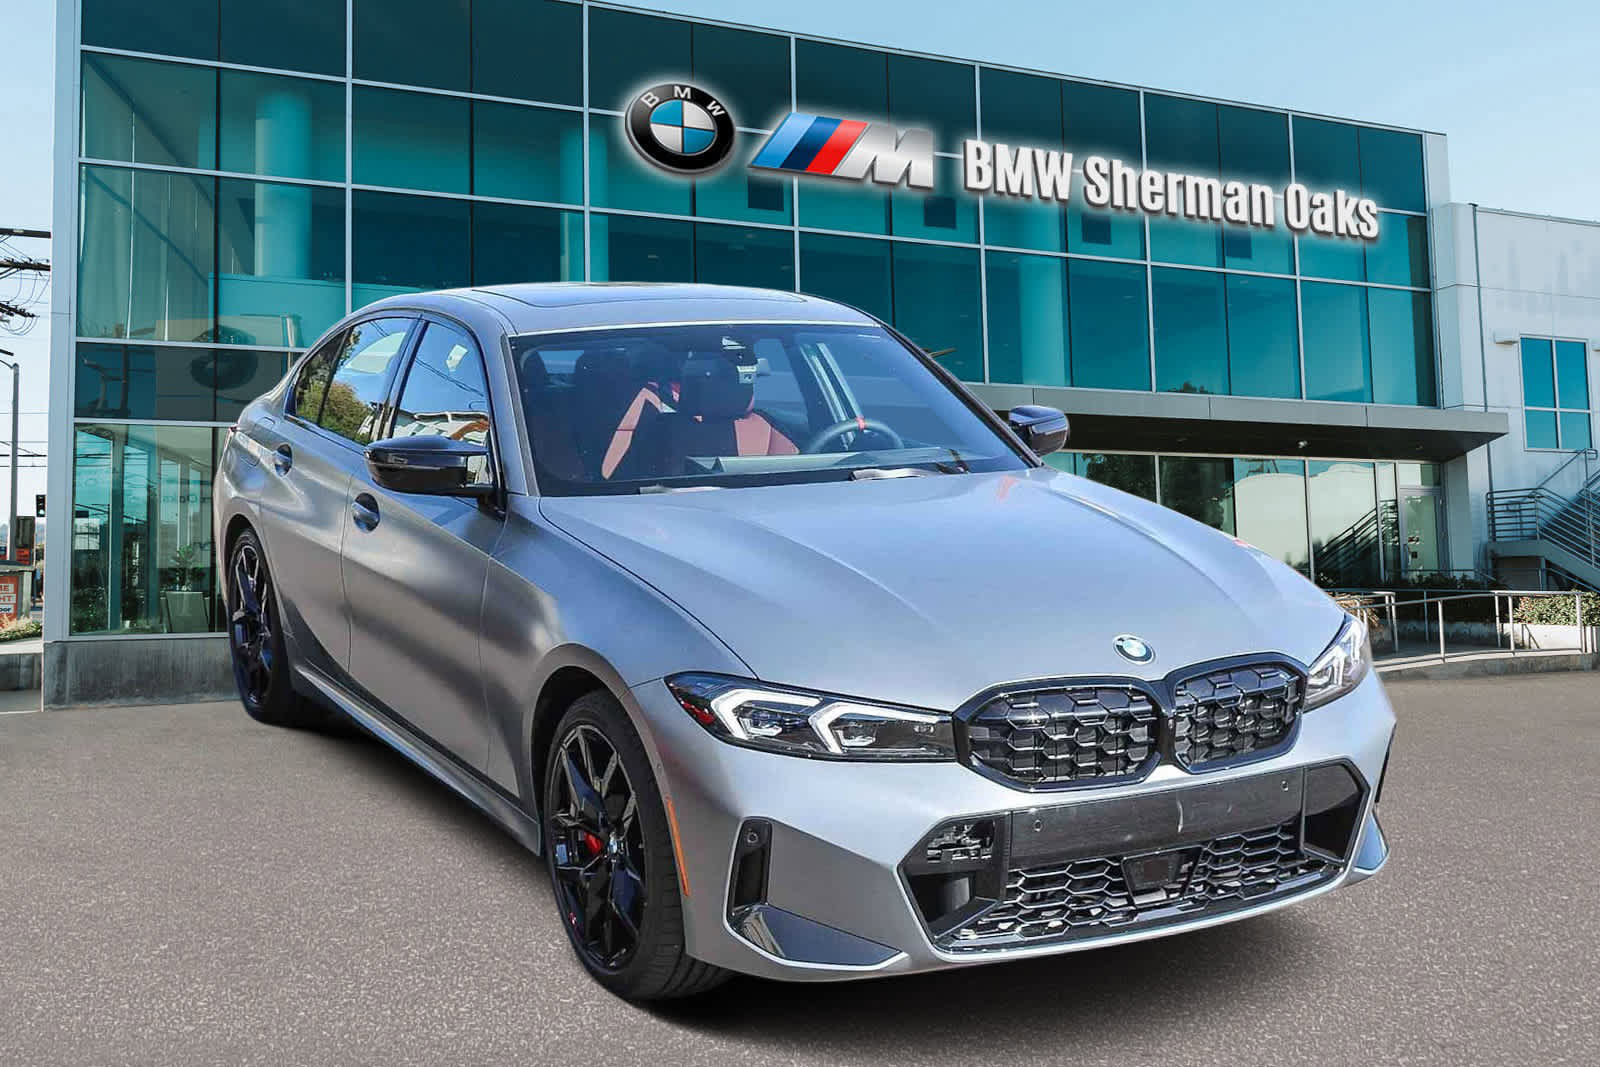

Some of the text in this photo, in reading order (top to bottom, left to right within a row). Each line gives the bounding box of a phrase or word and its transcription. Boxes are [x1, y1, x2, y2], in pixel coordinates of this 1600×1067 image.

[640, 84, 726, 118] BMW
[963, 138, 1379, 241] BMW Sherman Oaks
